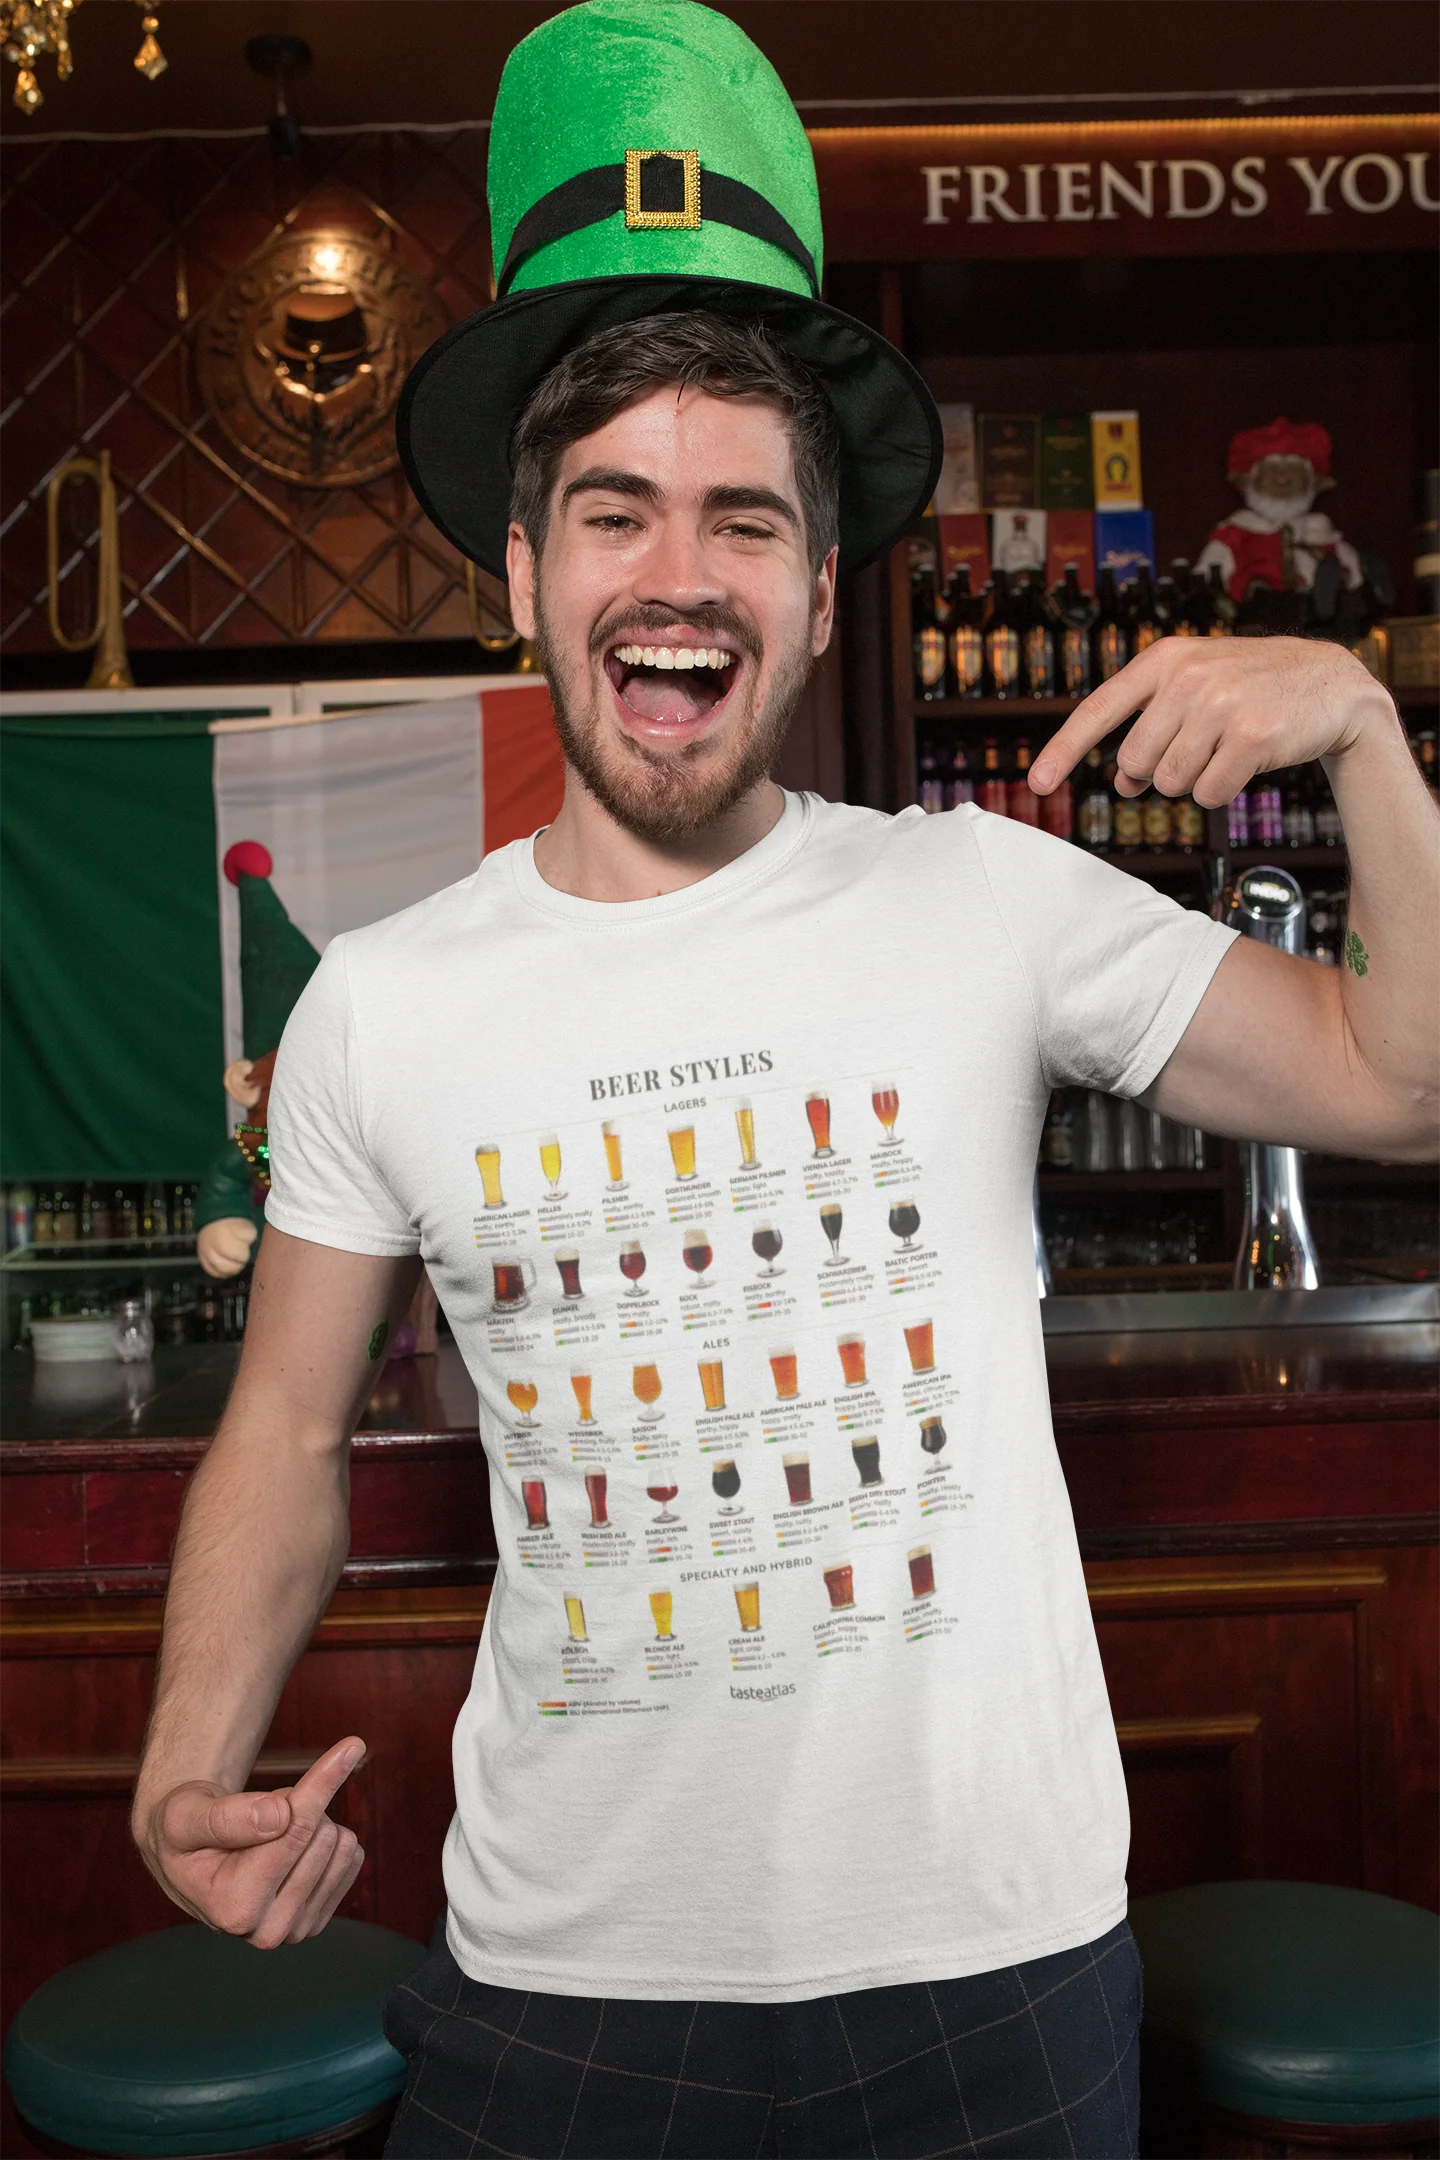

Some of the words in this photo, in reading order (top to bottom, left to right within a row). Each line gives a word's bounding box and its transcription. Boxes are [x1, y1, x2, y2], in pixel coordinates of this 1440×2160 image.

[920, 157, 1268, 225] FRIENDS
[1287, 151, 1440, 216] YOU
[589, 1069, 662, 1101] BEER
[670, 1050, 774, 1088] STYLES
[664, 1098, 707, 1113] LAGERS
[871, 1150, 902, 1160] MAIBOCK
[803, 1162, 828, 1172] VIENNA
[830, 1158, 852, 1167] LAGER
[730, 1175, 758, 1184] GERMAN
[759, 1169, 786, 1179] PILSNER
[665, 1182, 711, 1194] DORTMUNDER
[473, 1213, 507, 1223] AMERICAN
[509, 1210, 530, 1219] LAGER
[538, 1206, 561, 1214] HELLES
[885, 1257, 909, 1267] BALTIC
[910, 1252, 938, 1262] PORTER
[817, 1265, 867, 1280] SCHWARZBIER
[743, 1282, 772, 1292] EISBOCK
[553, 1305, 579, 1314] DUNKEL
[617, 1300, 660, 1309] DOPPELBOCK
[703, 1338, 730, 1349] ALES
[902, 1376, 939, 1390] AMERICAN
[940, 1374, 952, 1382] IPA
[834, 1394, 863, 1404] ENGLISH
[760, 1406, 795, 1416] AMERICAN
[814, 1400, 827, 1408] ALE
[696, 1417, 724, 1425] ENGLISH
[631, 1425, 657, 1434] SAISON
[917, 1476, 945, 1490] PORTER
[849, 1493, 869, 1505] IRISH
[884, 1488, 906, 1496] STOUT
[773, 1510, 801, 1520] ENGLISH
[803, 1505, 830, 1516] BROWN
[831, 1500, 844, 1509] ALE
[709, 1520, 732, 1529] SWEET
[734, 1517, 755, 1526] STOUT
[541, 1533, 554, 1541] ALE
[645, 1526, 688, 1536] BARLEYWINE
[680, 1568, 738, 1582] SPECIALTY
[743, 1563, 766, 1575] AND
[771, 1557, 812, 1571] HYBRID
[813, 1617, 853, 1632] CALIFORNIA
[855, 1615, 886, 1623] COMMON
[728, 1637, 752, 1645] CREAM
[730, 1683, 796, 1700] tasteatlas
